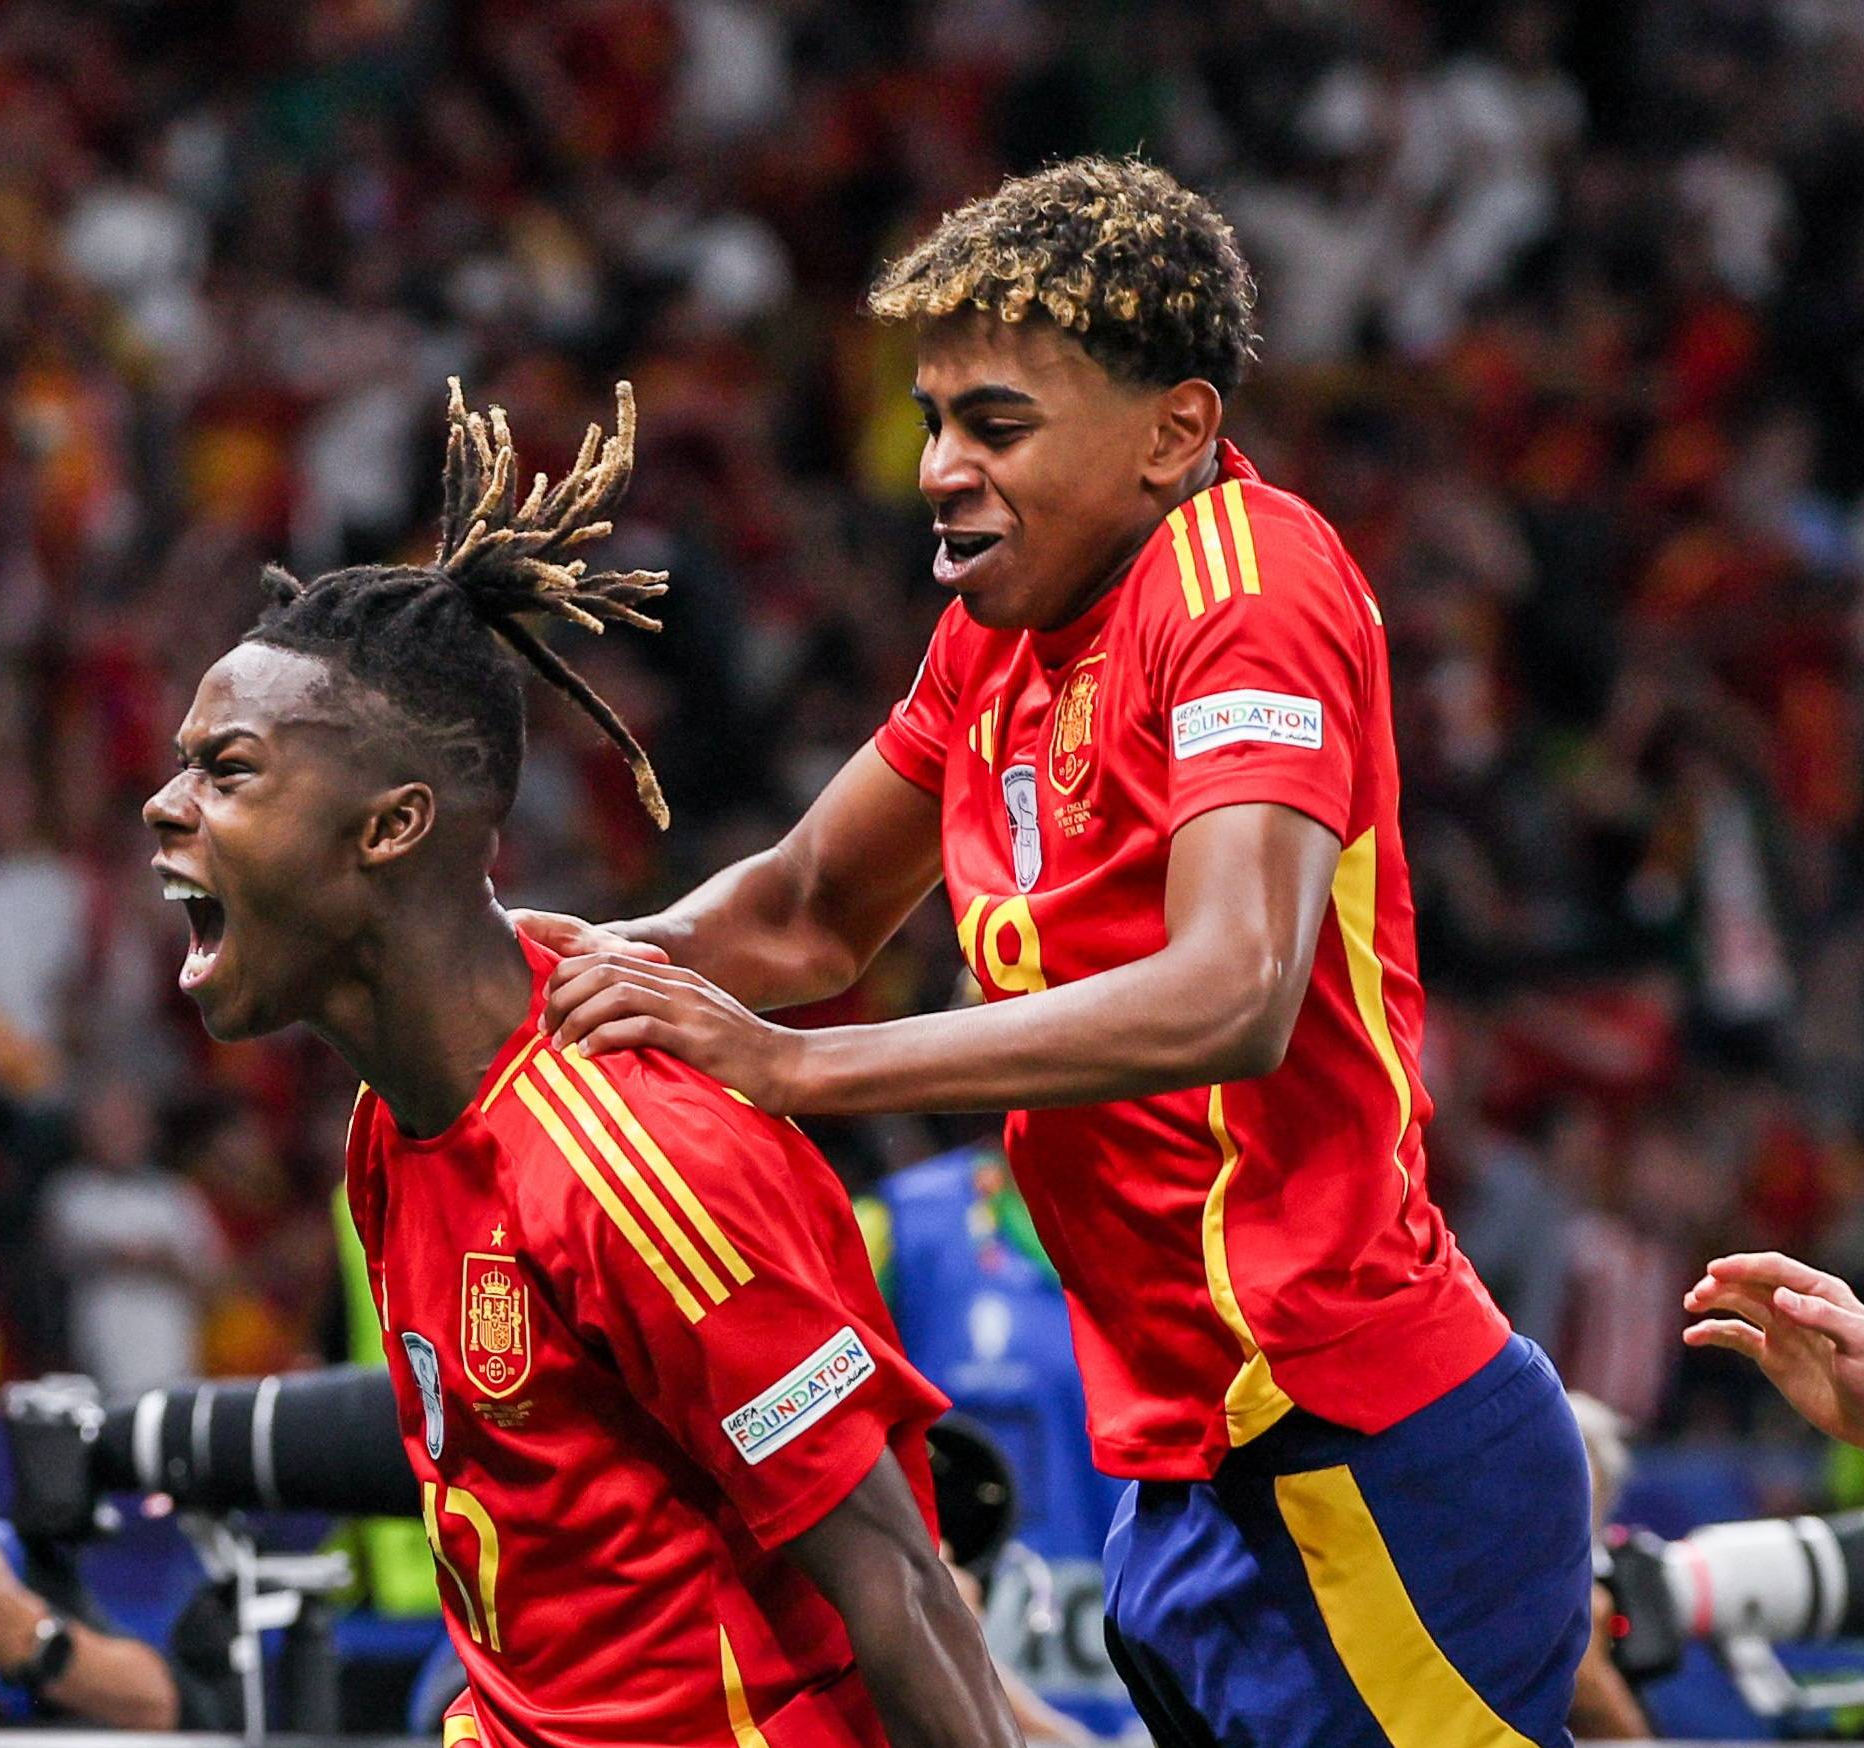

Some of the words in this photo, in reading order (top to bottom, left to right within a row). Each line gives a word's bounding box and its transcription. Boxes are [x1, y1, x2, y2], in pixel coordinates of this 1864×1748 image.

[1177, 708, 1317, 740] FOUNDATION
[728, 1407, 758, 1431] UEFA
[735, 1343, 863, 1447] FOUNDATION
[423, 1481, 501, 1653] 17
